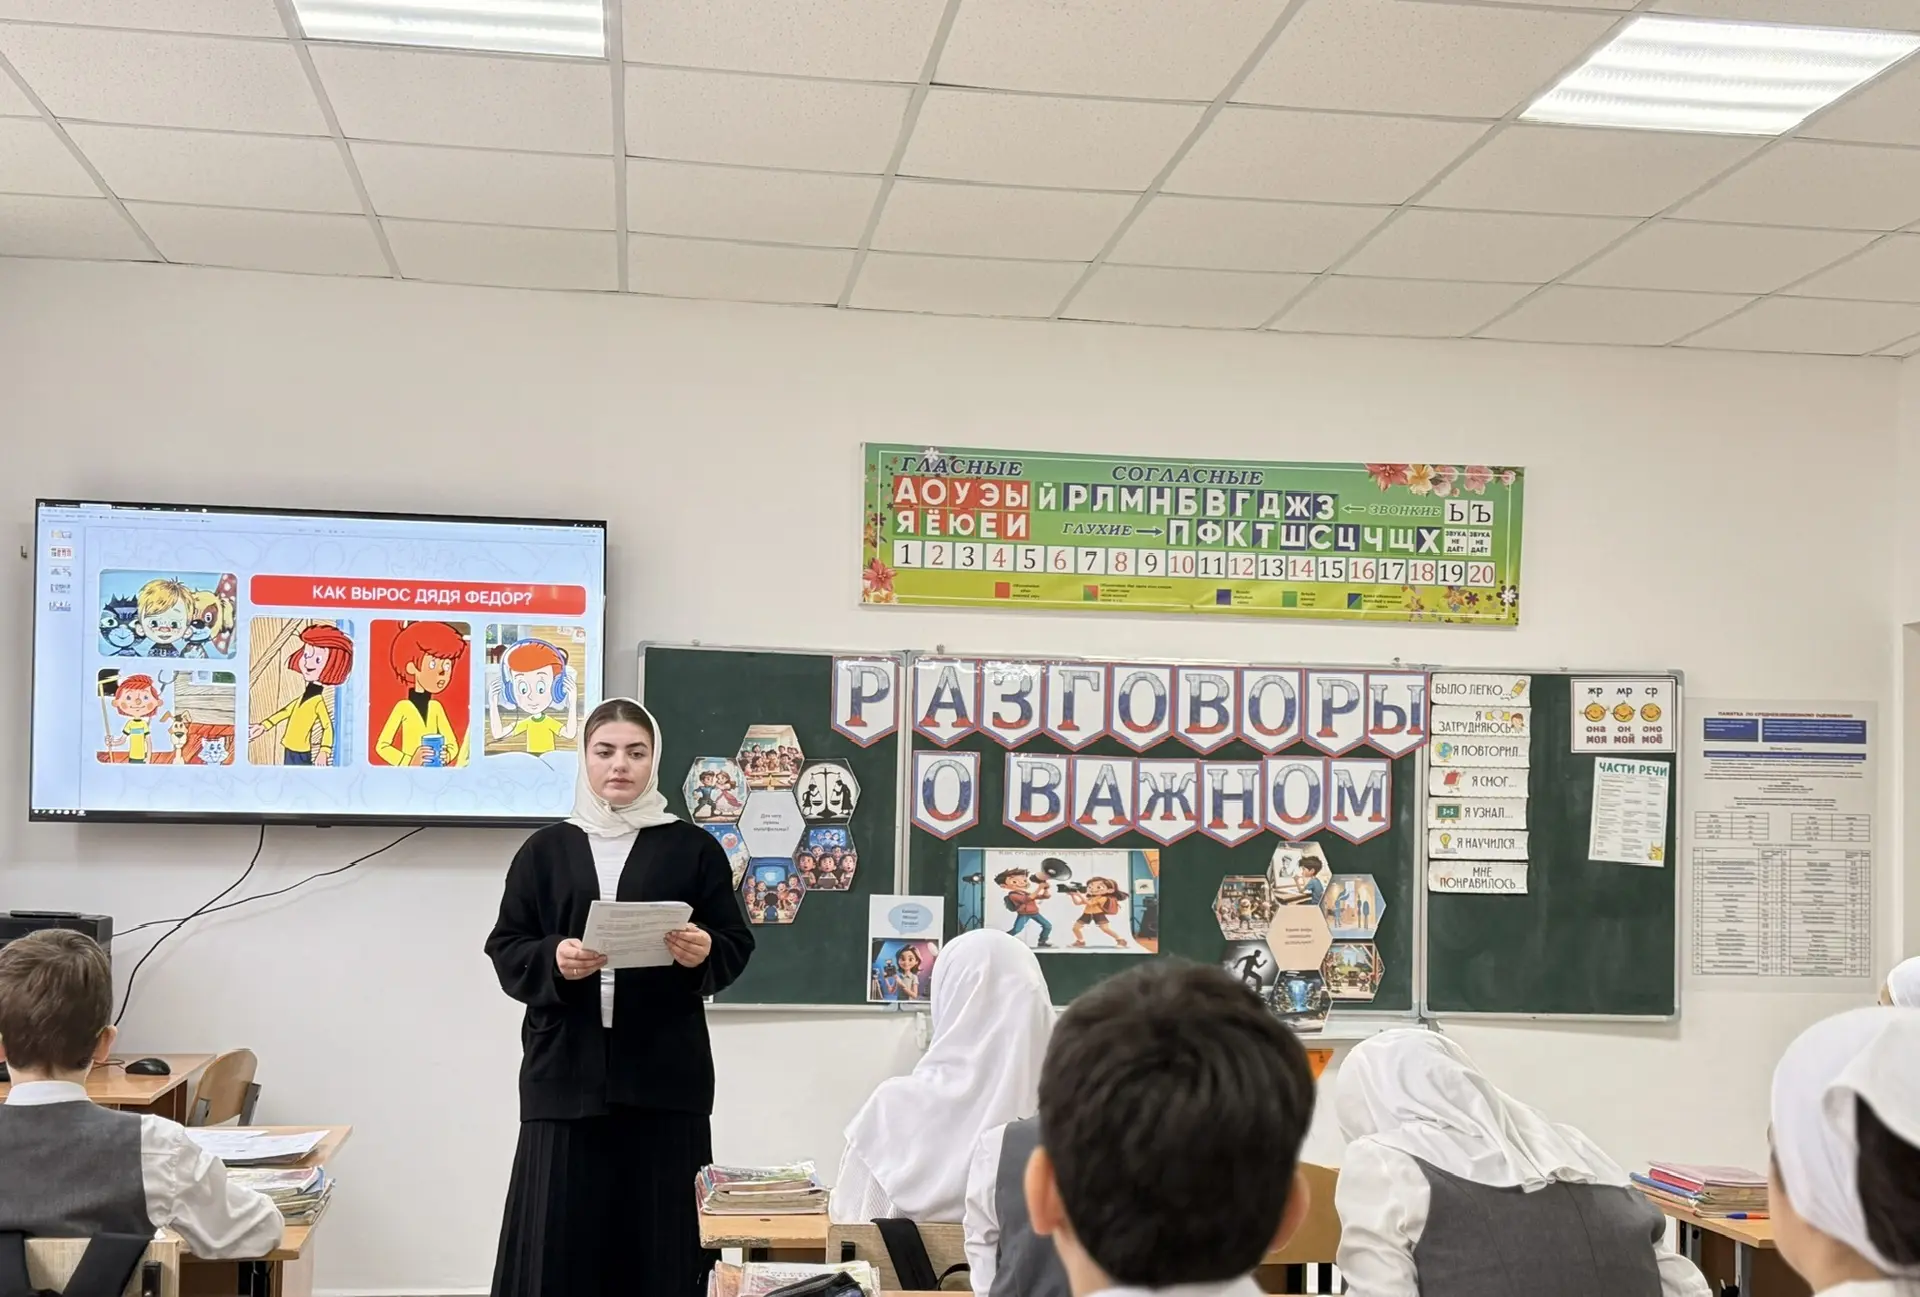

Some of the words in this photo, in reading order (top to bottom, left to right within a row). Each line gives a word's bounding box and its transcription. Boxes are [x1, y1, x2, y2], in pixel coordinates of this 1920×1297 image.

[901, 457, 1022, 476] ГЛАСНЫЕ
[1112, 466, 1263, 485] СОГЛАСНЫЕ
[1368, 504, 1441, 516] ЗВОНКИЕ
[1063, 523, 1132, 535] ГЛУХИЕ
[901, 544, 912, 564] 1
[932, 545, 943, 565] 2
[962, 547, 974, 566] 3
[993, 548, 1006, 567] 4
[1024, 549, 1036, 569] 5
[1054, 550, 1066, 570] 6
[1085, 551, 1097, 570] 7
[1115, 552, 1127, 572] 8
[1145, 553, 1157, 573] 9
[1170, 556, 1194, 573] 10
[1201, 557, 1224, 575] 11
[1230, 558, 1253, 575] 12
[1261, 559, 1283, 576] 13
[1290, 559, 1313, 577] 14
[1320, 561, 1343, 578] 15
[1351, 561, 1374, 579] 16
[1380, 563, 1404, 580] 17
[1410, 563, 1434, 581] 18
[1440, 564, 1463, 582] 19
[1469, 565, 1494, 583] 20
[313, 585, 346, 600] КАК
[351, 587, 411, 602] ВЫРОС
[415, 589, 460, 604] ДЯДЯ
[465, 590, 532, 606] ФЕДОР?
[1436, 684, 1467, 694] БЫЛО
[845, 665, 1426, 738] РАЗГОВОРЫ
[1476, 711, 1481, 721] Я
[1614, 734, 1635, 744] мой
[1642, 735, 1663, 744] моё
[1453, 745, 1459, 755] Я
[1599, 762, 1635, 774] ЧАСТИ
[1639, 764, 1667, 776] РЕЧИ
[1472, 777, 1477, 786] Я
[923, 759, 971, 821] О
[1015, 761, 1386, 829] ВАЖНОМ
[1465, 808, 1470, 817] Я
[1457, 838, 1463, 848] Я
[1473, 867, 1491, 877] МНЕ
